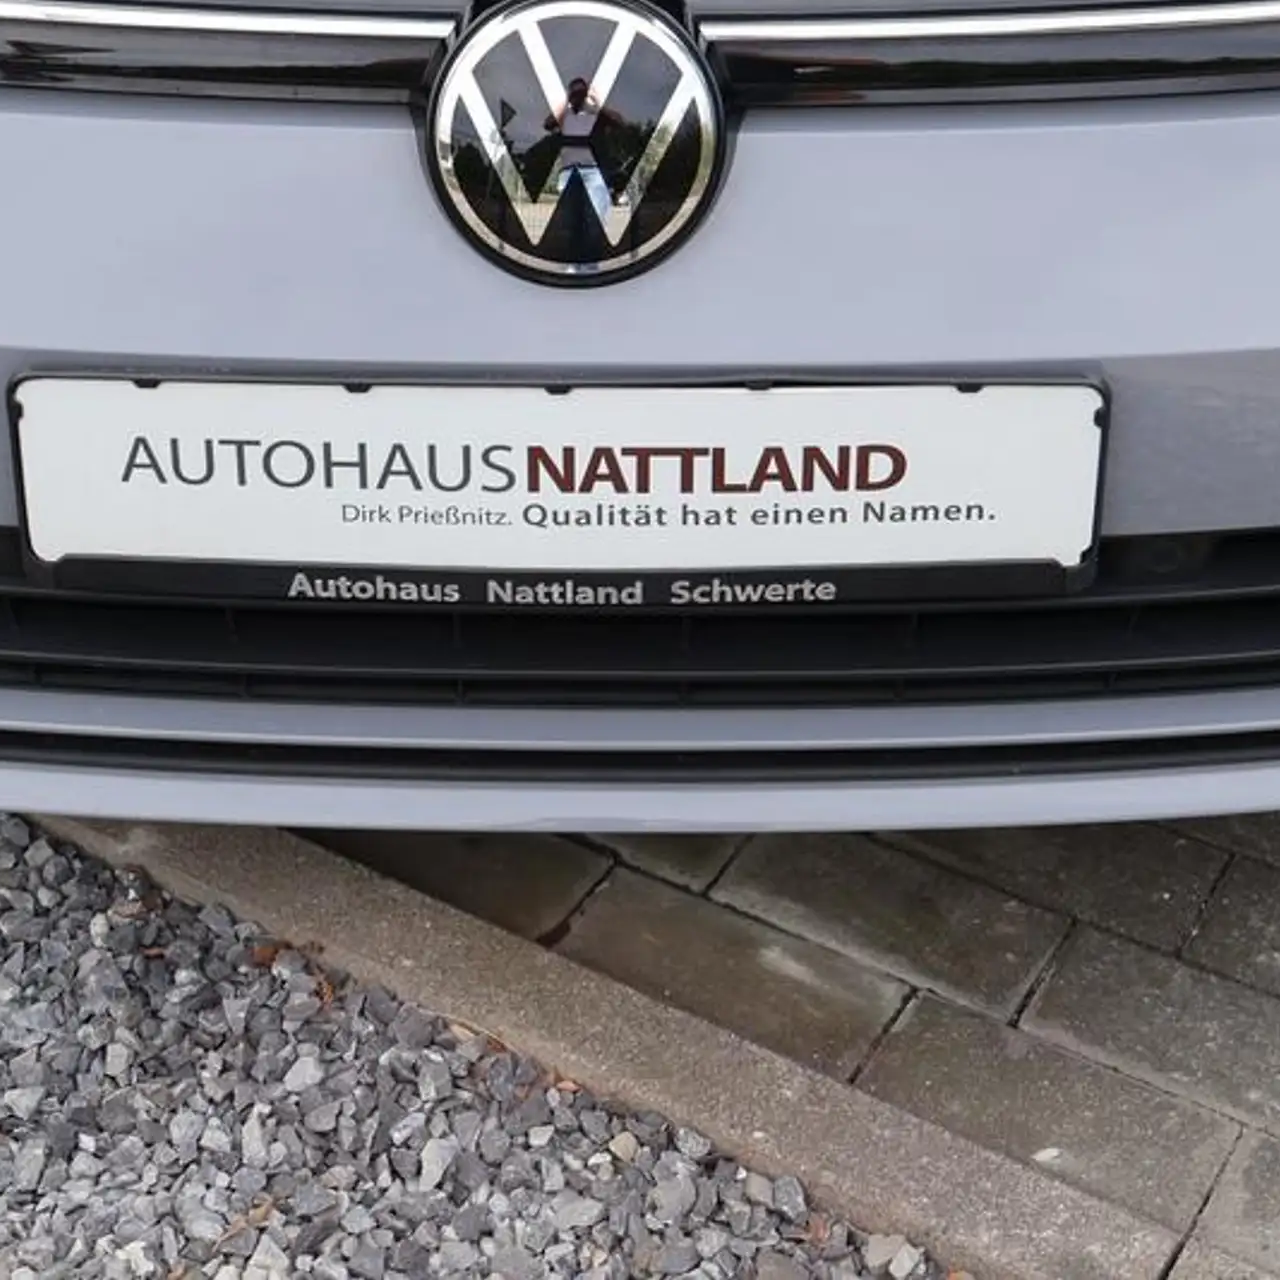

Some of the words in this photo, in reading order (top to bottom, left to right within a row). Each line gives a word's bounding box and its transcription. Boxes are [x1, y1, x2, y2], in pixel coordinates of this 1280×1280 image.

[341, 504, 392, 524] Dirk
[398, 505, 514, 526] Prießnitz.
[522, 503, 668, 529] Qualität
[681, 503, 738, 527] hat
[750, 502, 848, 526] einen
[862, 500, 997, 524] Namen.
[288, 572, 461, 602] Autohaus
[487, 579, 644, 605] Nattland
[670, 578, 838, 604] Schwerte
